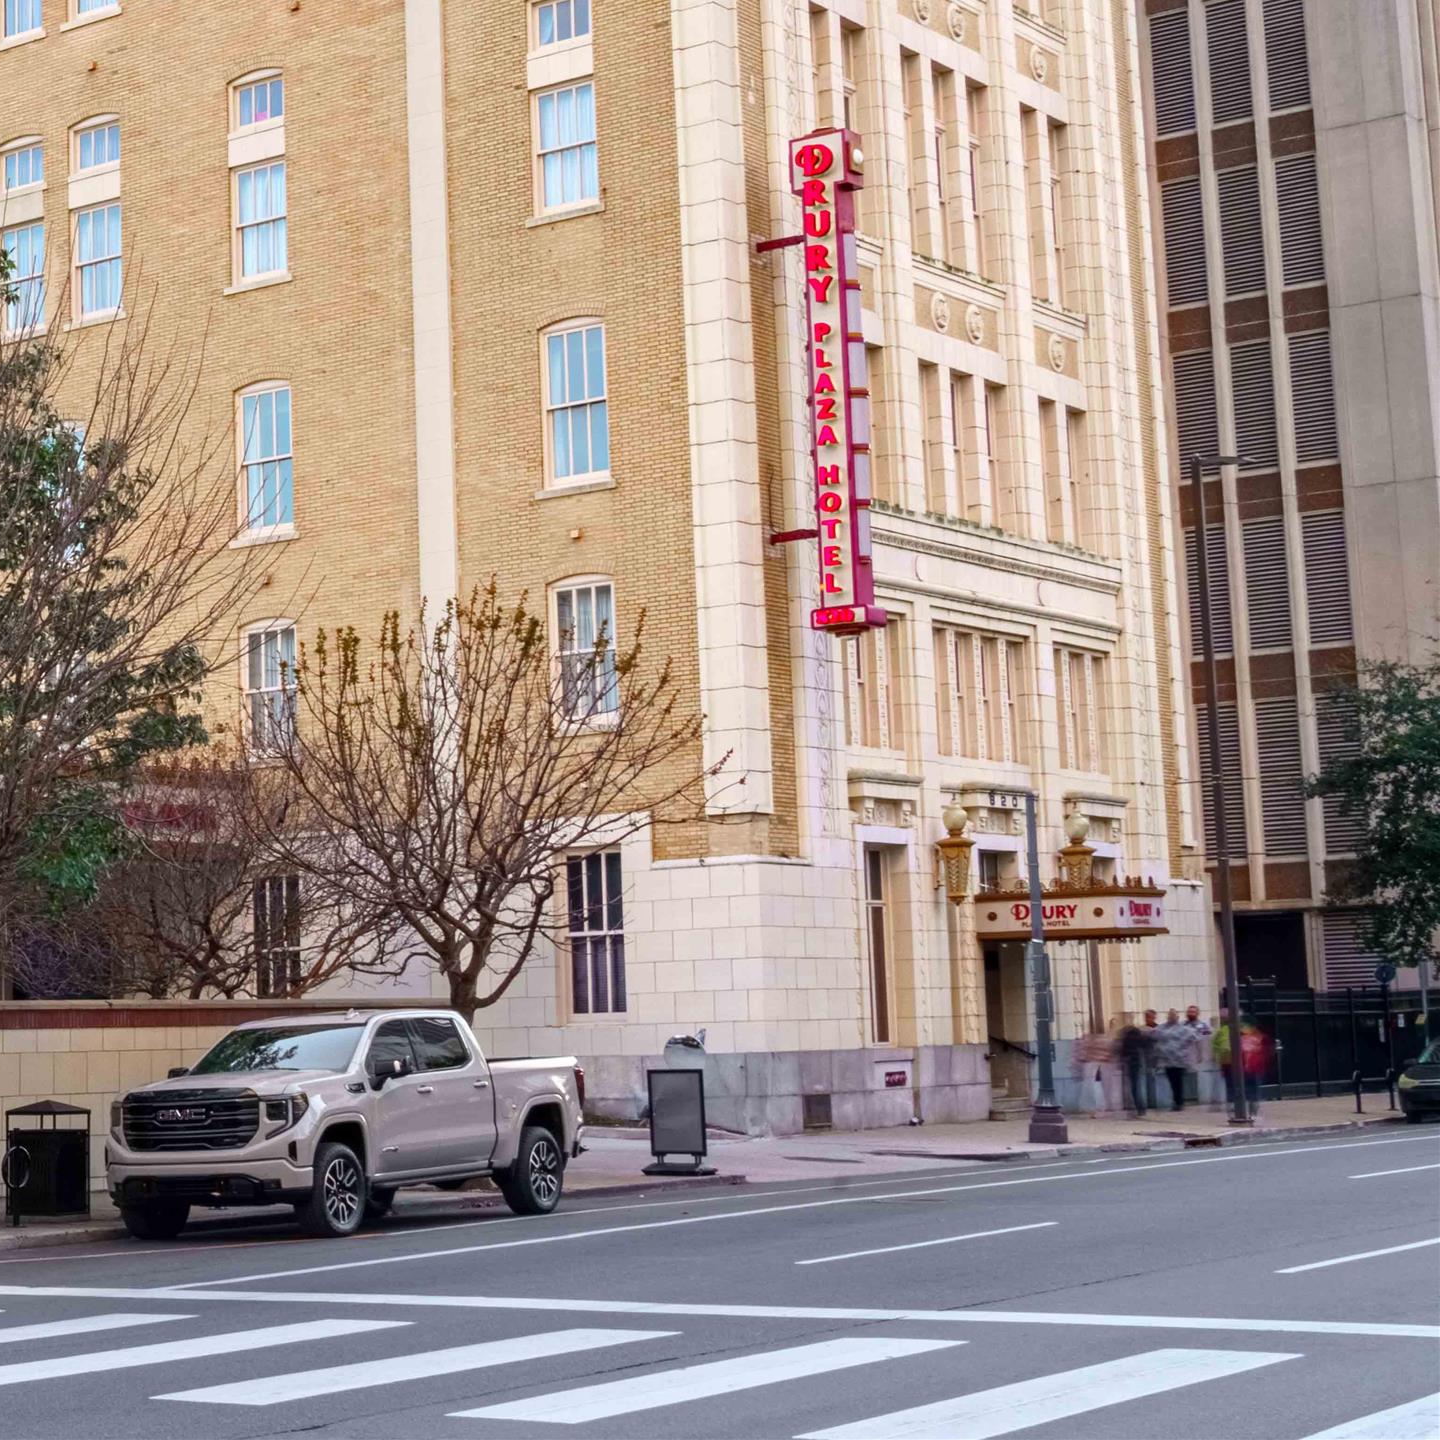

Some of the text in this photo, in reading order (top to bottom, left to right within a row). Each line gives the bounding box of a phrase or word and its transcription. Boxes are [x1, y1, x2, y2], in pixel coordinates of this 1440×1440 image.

[794, 144, 842, 594] DRURY PLAZA HOTEL
[989, 793, 1018, 807] 820
[1010, 903, 1078, 920] DURY
[157, 1108, 206, 1121] GMC
